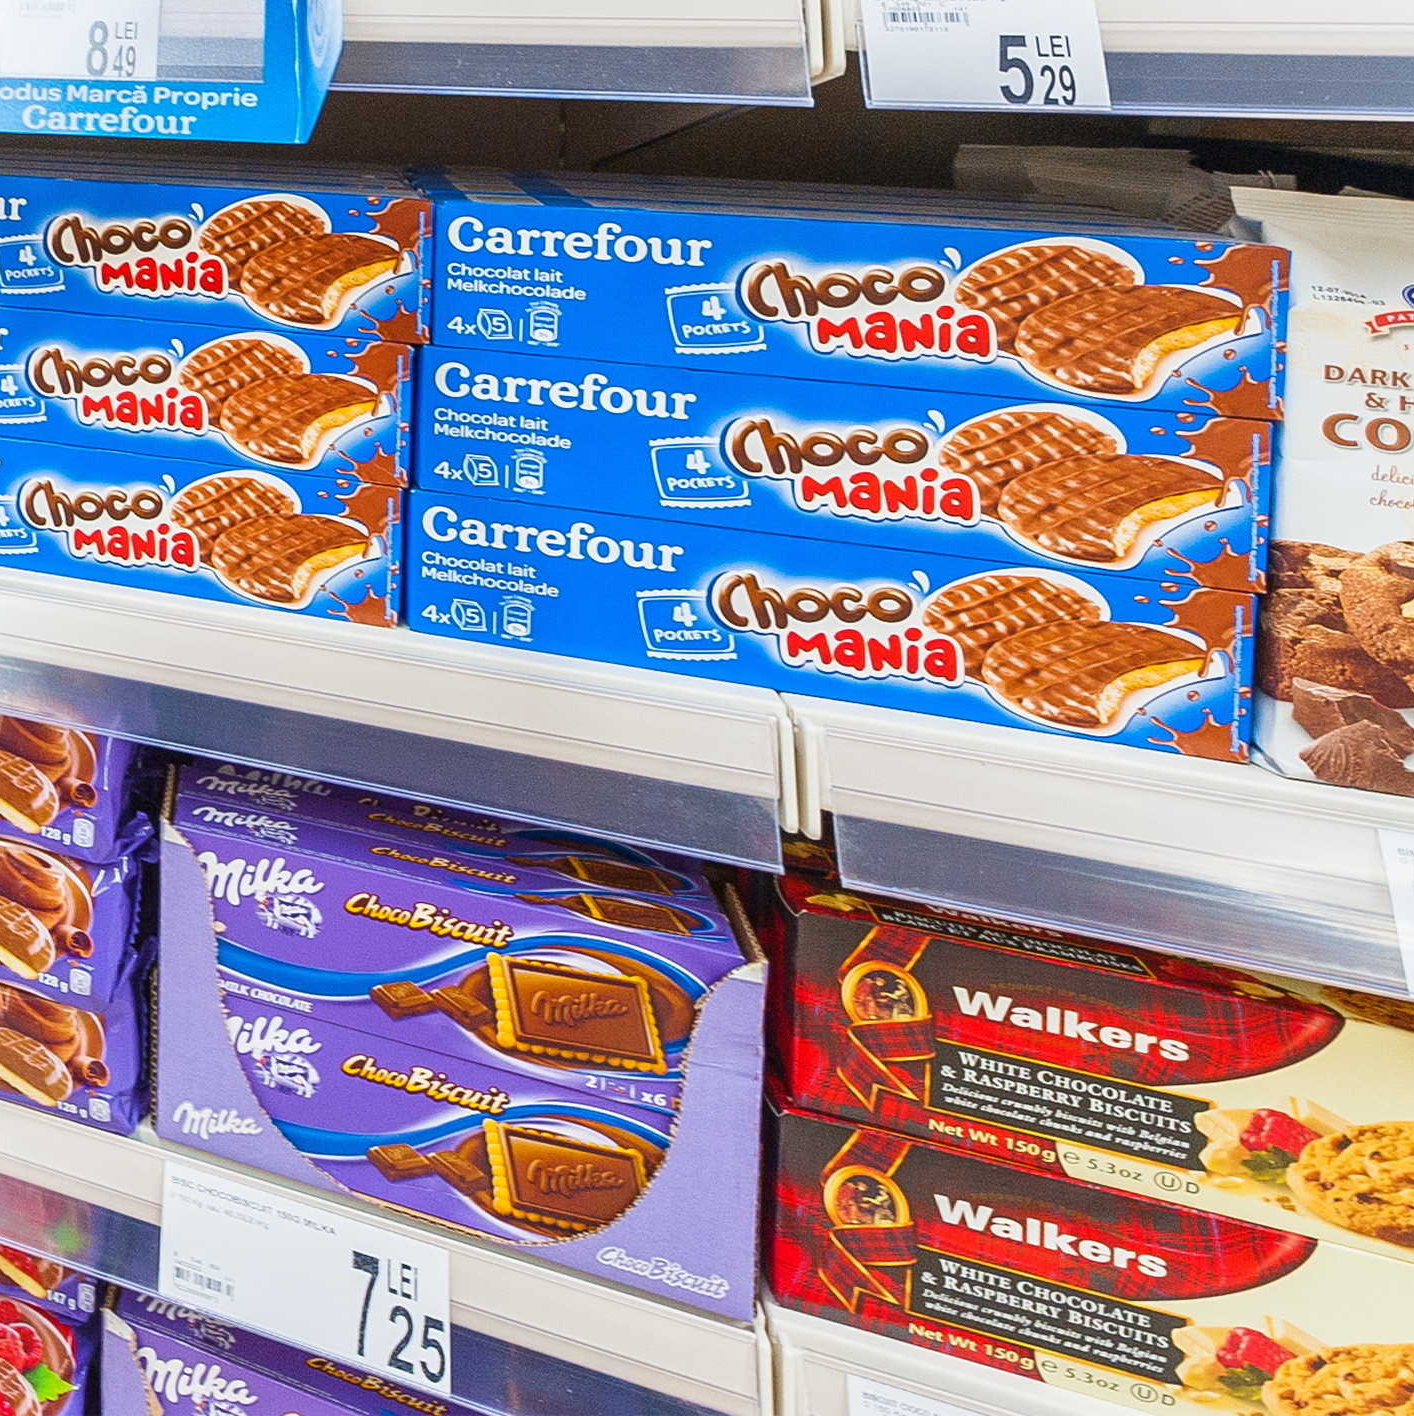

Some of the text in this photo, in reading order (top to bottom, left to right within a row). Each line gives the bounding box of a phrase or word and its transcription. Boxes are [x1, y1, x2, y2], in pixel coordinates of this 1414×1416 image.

[85, 20, 139, 77] 8 LEI
[112, 44, 137, 77] 49
[999, 35, 1071, 104] 5 LEI
[1040, 65, 1076, 105] 29
[68, 83, 147, 105] Marcă
[153, 87, 259, 111] Proprie
[21, 105, 197, 136] Carrefour
[447, 217, 712, 268] Carrefour
[741, 260, 946, 323] Choco
[447, 318, 478, 340] 4x
[680, 318, 752, 342] POCKETS
[1323, 364, 1410, 388] DARK
[343, 892, 516, 949] ChocoBiscuit
[252, 988, 313, 1013] CHOCOLATE
[532, 989, 628, 1028] Milka
[951, 985, 1190, 1063] Walkers
[940, 1065, 1192, 1135] & RASPBERRY BISCUITS
[957, 1050, 1173, 1113] WHITE CHOCOLATE
[173, 1102, 265, 1140] Milka
[928, 1118, 999, 1147] Net Wt
[1139, 1128, 1190, 1149] Belgian
[1115, 1134, 1187, 1160] raspberries
[351, 1250, 418, 1357] 7 LEI
[387, 1305, 446, 1384] 25
